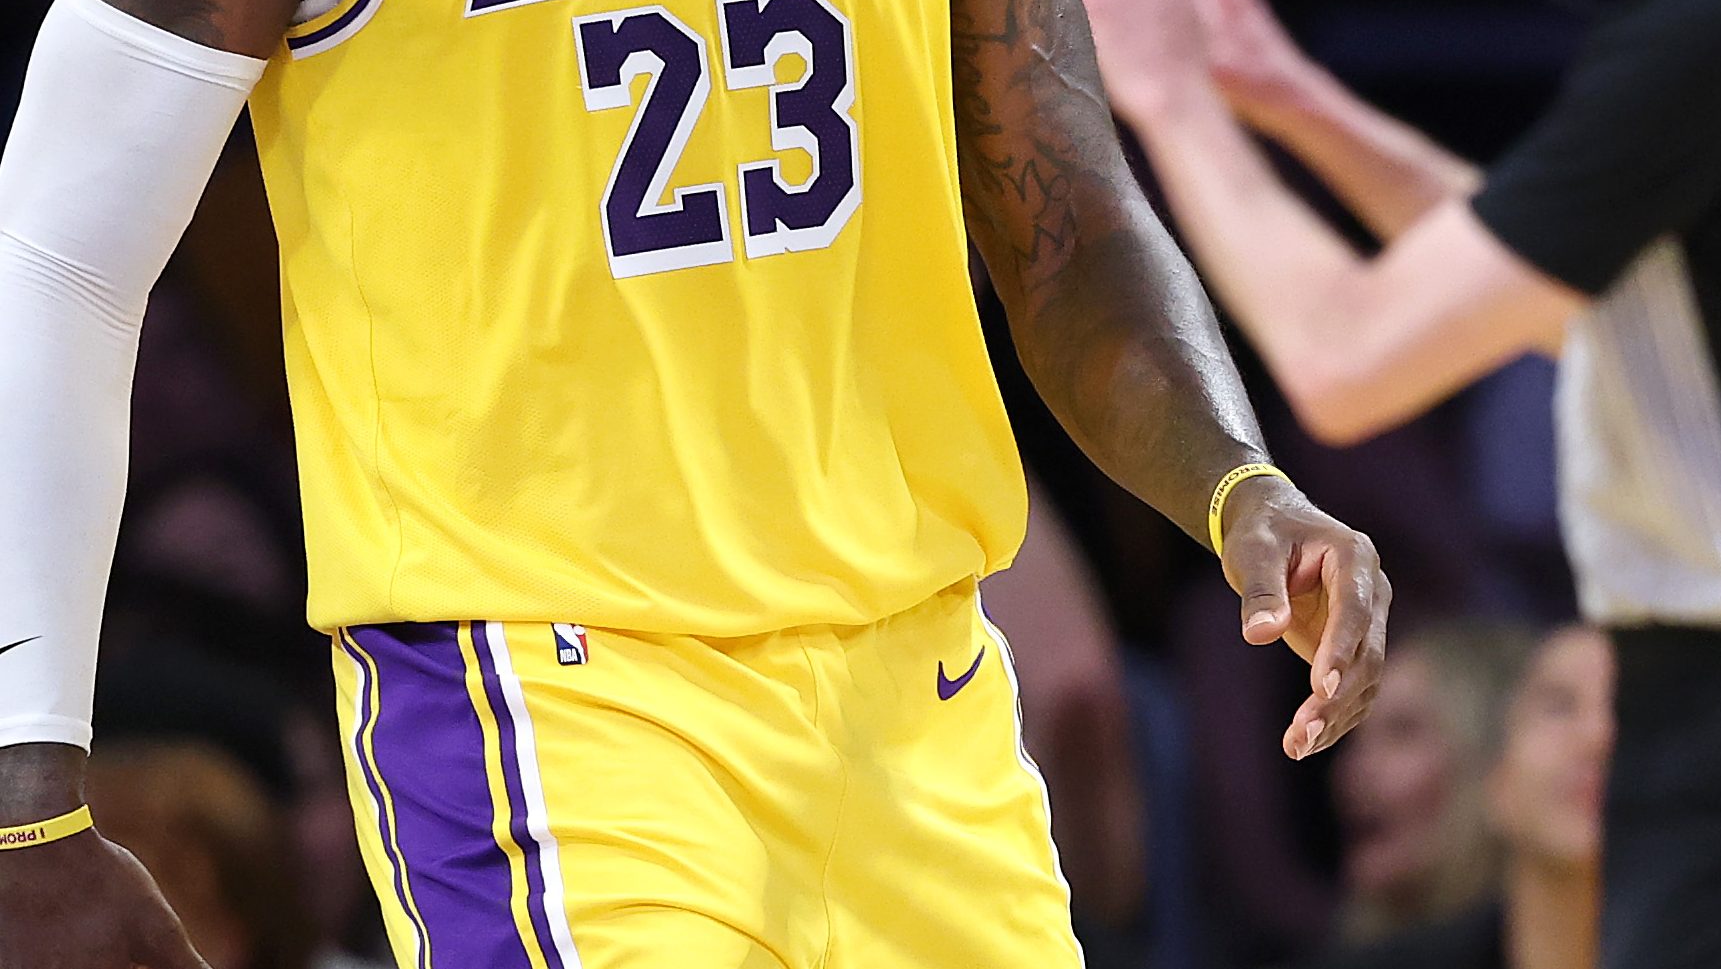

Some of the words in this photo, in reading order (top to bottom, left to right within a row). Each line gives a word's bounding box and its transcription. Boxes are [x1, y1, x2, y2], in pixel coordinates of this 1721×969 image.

[1211, 466, 1261, 516] PROMISE
[559, 647, 578, 663] NBA
[40, 827, 46, 838] I
